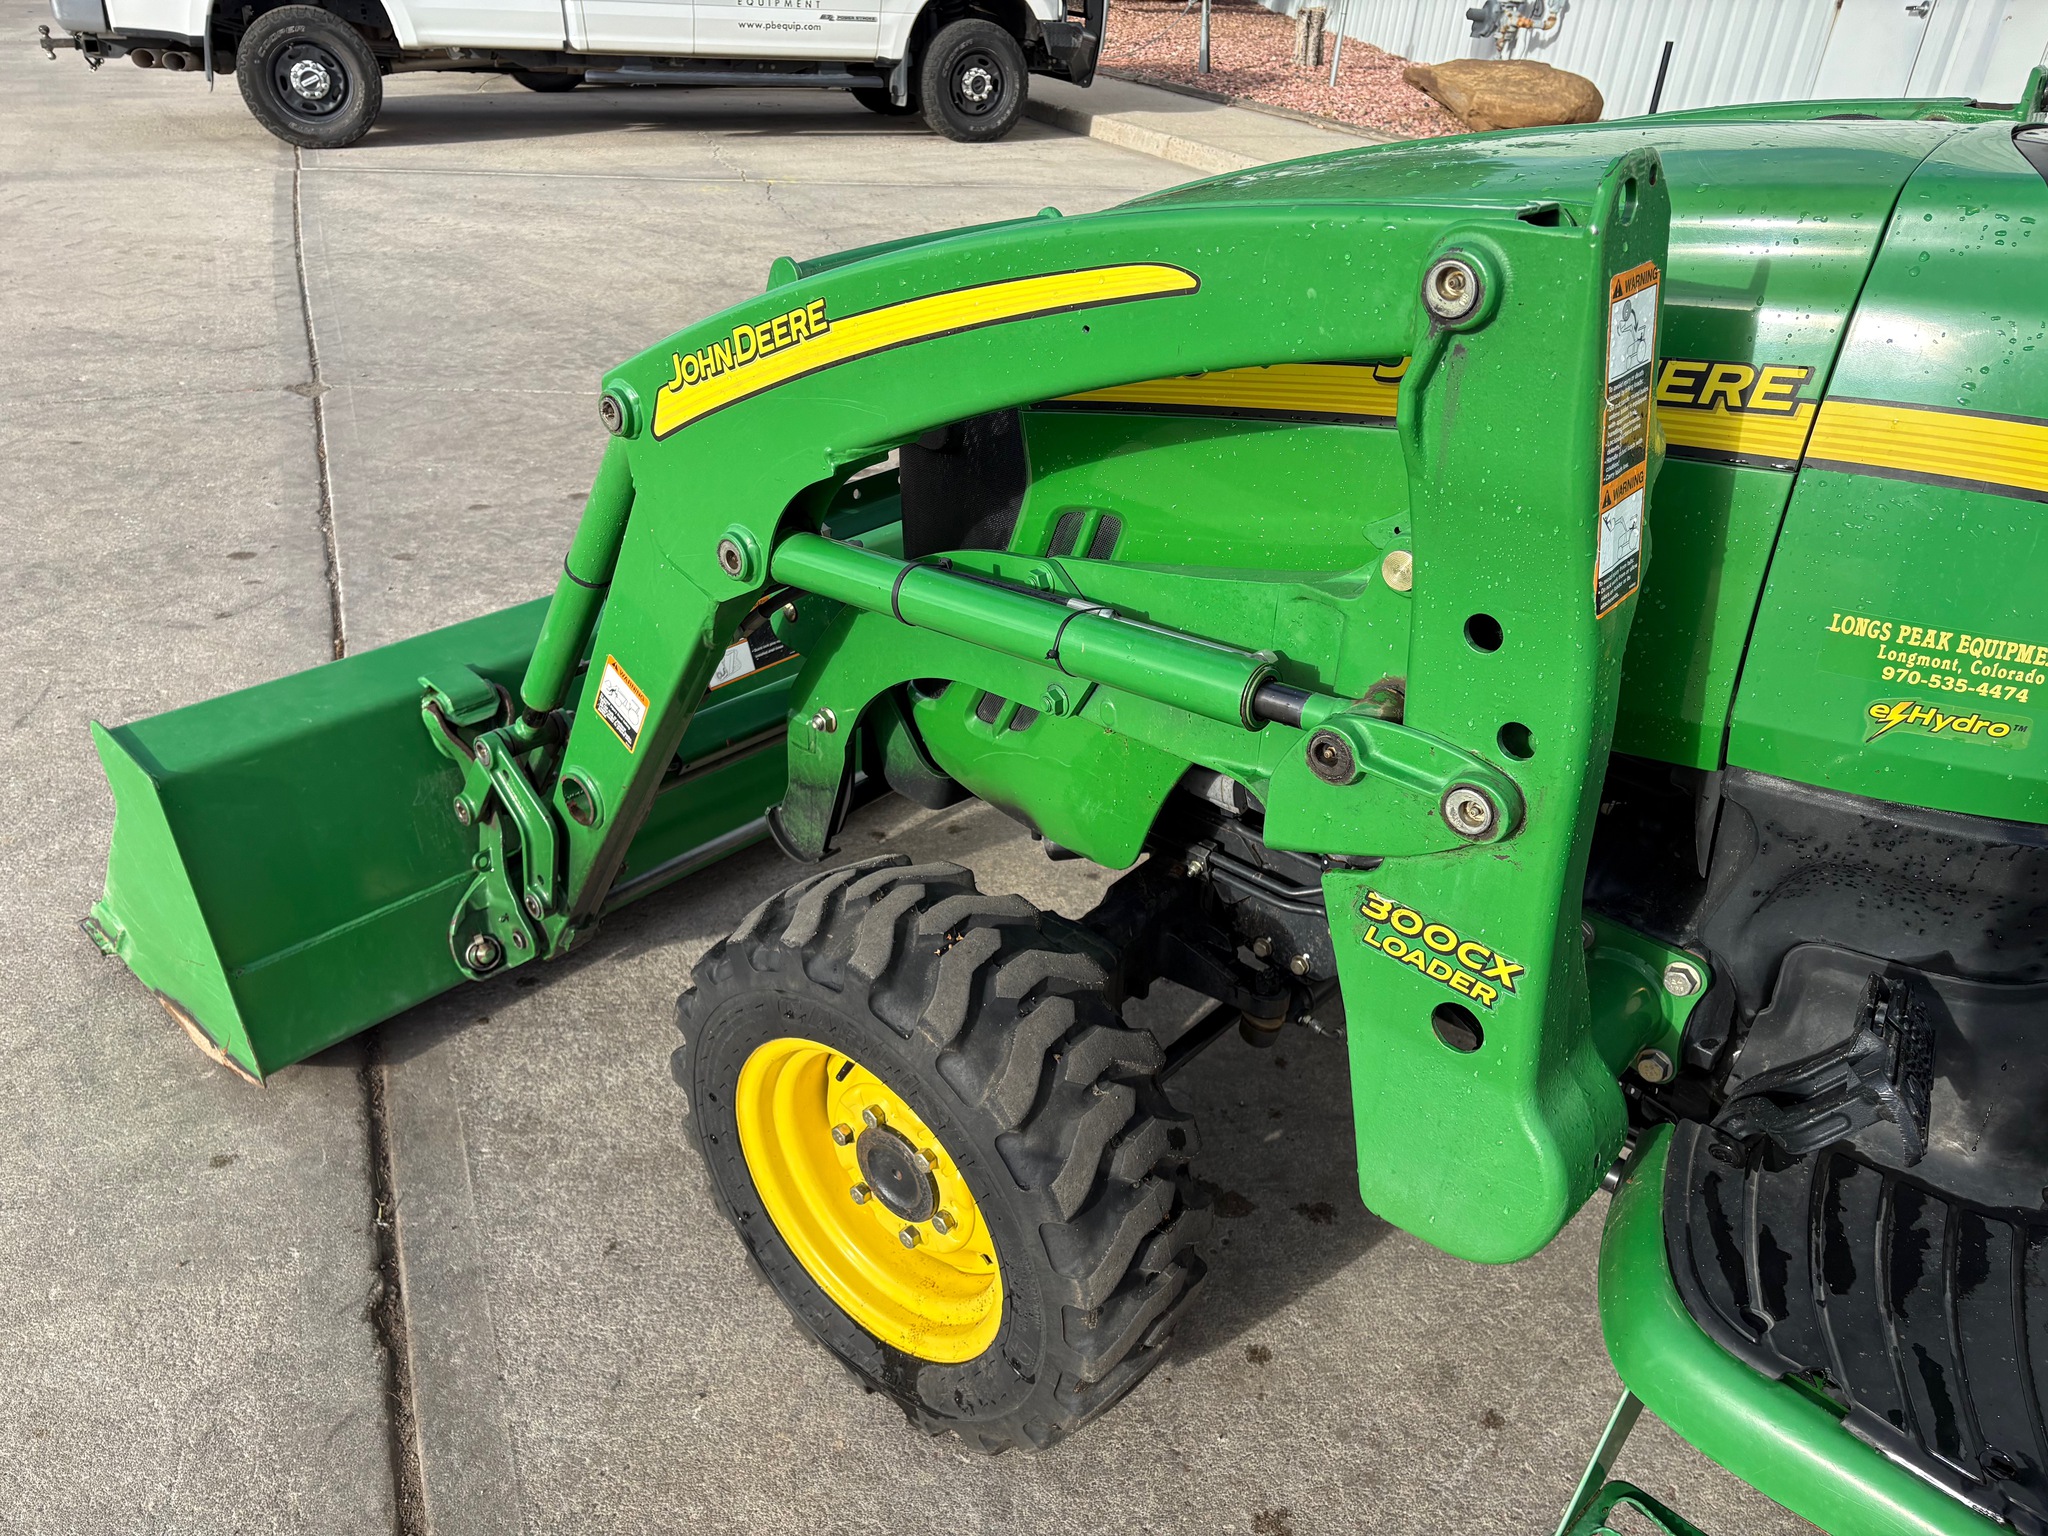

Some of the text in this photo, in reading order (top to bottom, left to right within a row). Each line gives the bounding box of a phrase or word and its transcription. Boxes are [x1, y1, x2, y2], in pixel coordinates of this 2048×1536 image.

[738, 21, 822, 31] www.pbequip.com
[1625, 267, 1658, 293] WARNING
[668, 297, 831, 392] JOHN DEERE
[1657, 358, 1816, 416] ERE
[1613, 471, 1644, 500] WARNING
[1829, 613, 2048, 667] LONGS PEAK EQUIPME
[620, 668, 645, 702] WARNING
[1877, 644, 2045, 685] Longmont, Colorado
[1881, 666, 2030, 703] 970-535-4474
[1360, 890, 1525, 993] 300CX
[1362, 924, 1498, 1010] LOADER
